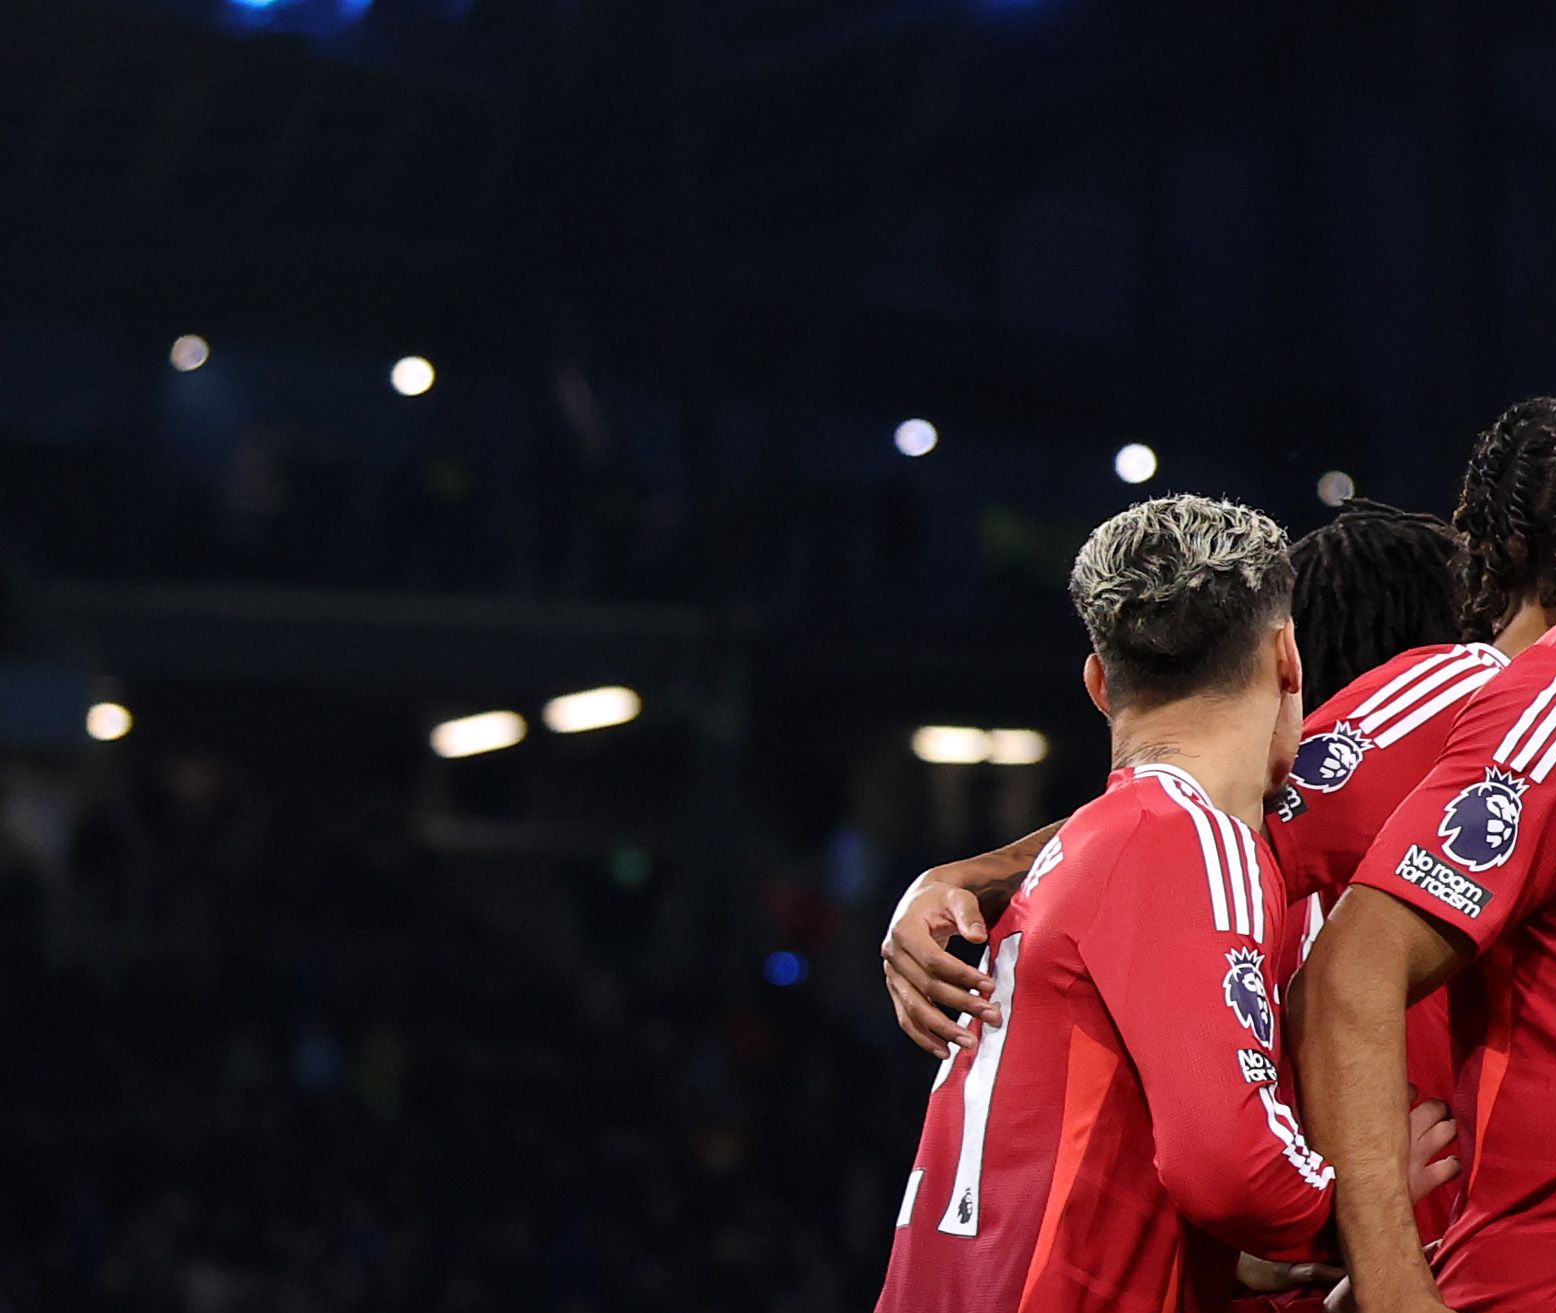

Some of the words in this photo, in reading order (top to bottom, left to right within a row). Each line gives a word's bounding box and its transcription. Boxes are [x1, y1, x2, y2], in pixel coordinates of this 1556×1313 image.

[1395, 860, 1426, 883] for
[1419, 876, 1481, 918] racism
[1403, 844, 1434, 872] No
[1430, 863, 1483, 903] room
[1237, 1049, 1264, 1068] No
